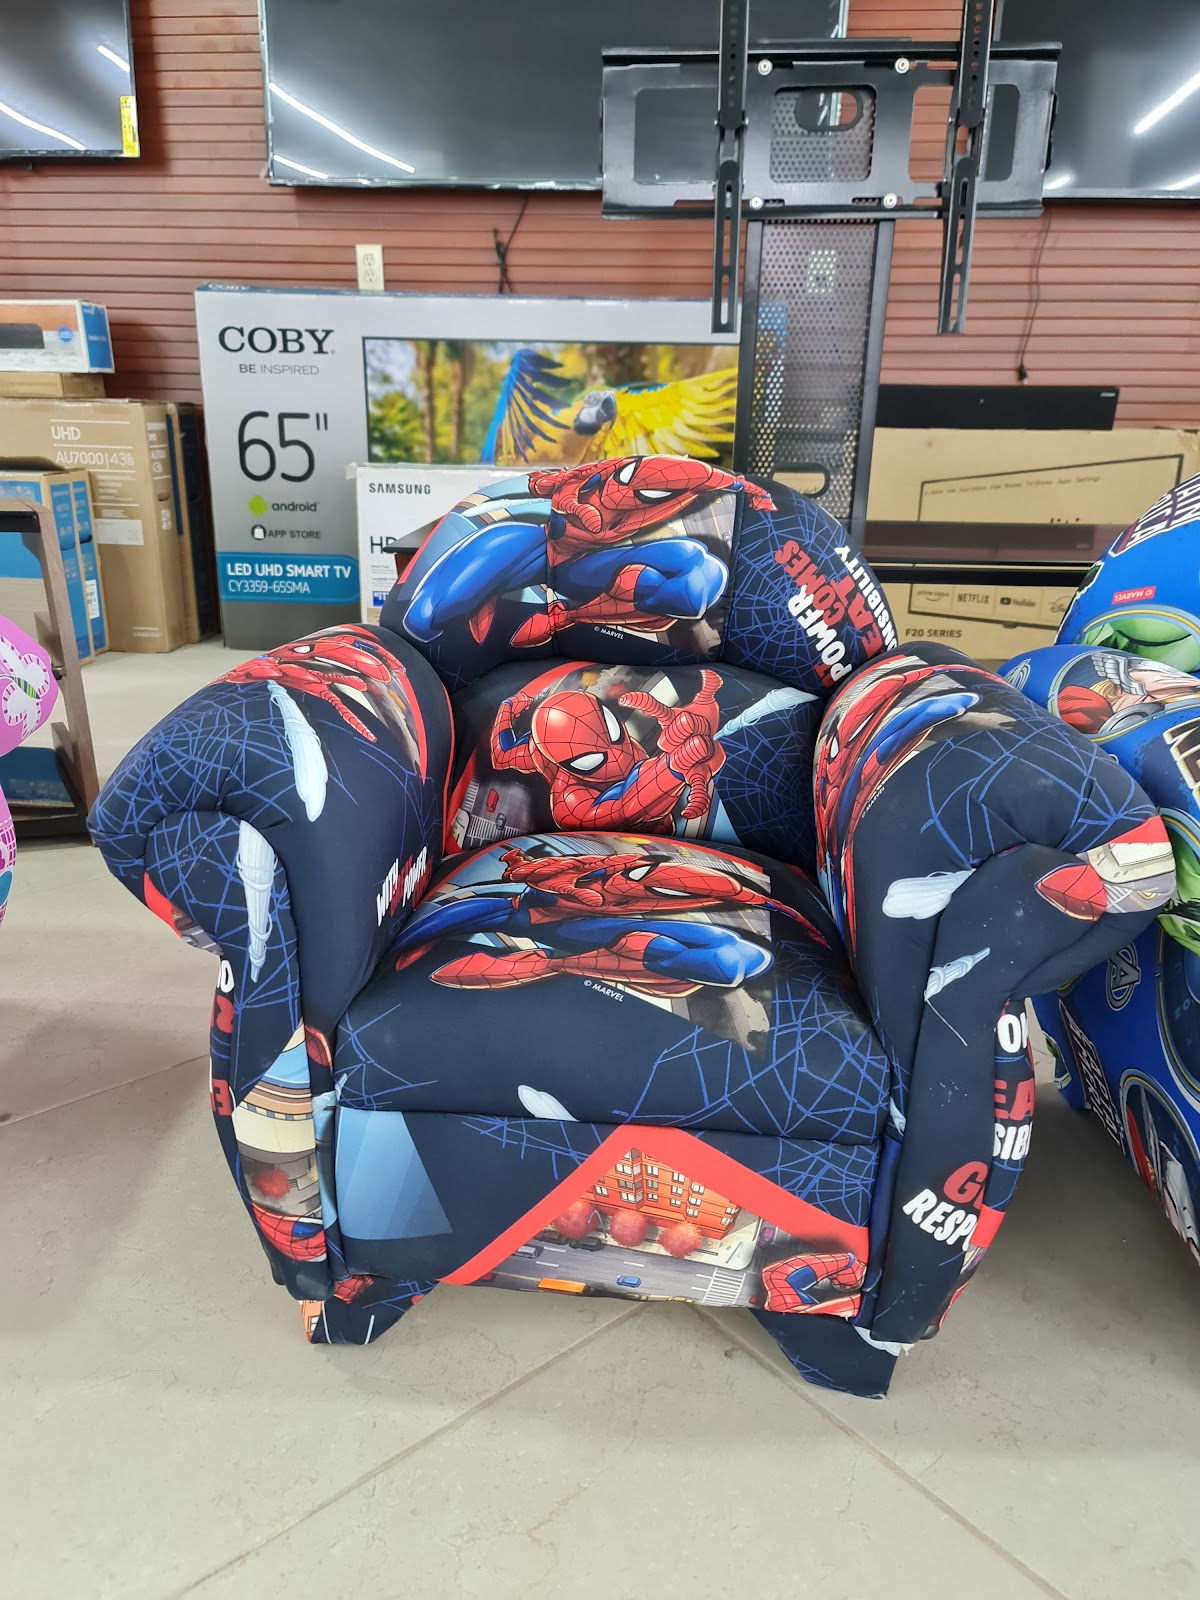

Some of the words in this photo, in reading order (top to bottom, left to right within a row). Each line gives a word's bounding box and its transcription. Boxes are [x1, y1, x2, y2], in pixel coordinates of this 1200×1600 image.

[218, 326, 334, 354] COBY
[239, 363, 257, 374] BE
[260, 364, 320, 376] INSPIRED
[51, 426, 81, 440] UHD
[56, 451, 104, 465] AU7000
[369, 483, 431, 494] SAMSUNG
[272, 501, 318, 512] android
[268, 530, 287, 539] APP
[290, 530, 321, 540] STORE
[226, 563, 252, 577] LED
[255, 563, 284, 577] UHD
[286, 564, 331, 578] SMART
[334, 566, 352, 579] TV
[774, 540, 845, 627] COMES
[957, 593, 990, 605] NETFLIX
[1115, 591, 1144, 602] MARVEL
[600, 628, 624, 640] MARVEL
[788, 584, 852, 682] POWER
[905, 628, 924, 638] F20
[927, 629, 962, 638] SERIES
[592, 984, 624, 1002] MARVEL
